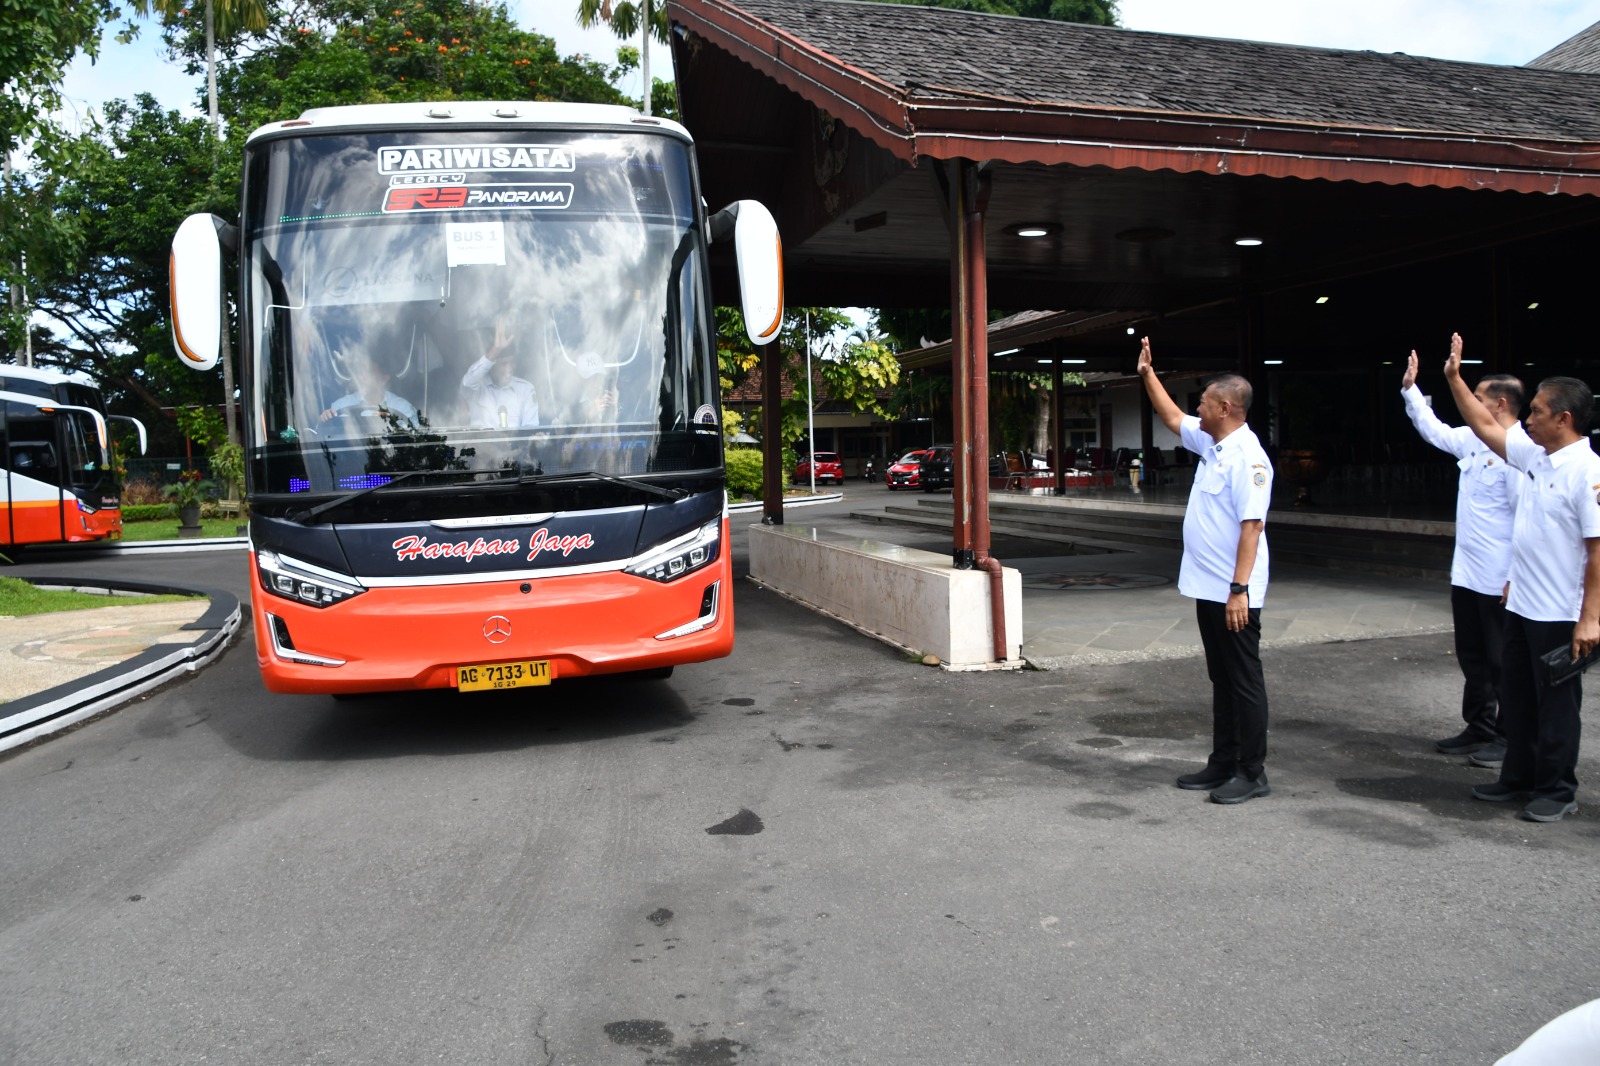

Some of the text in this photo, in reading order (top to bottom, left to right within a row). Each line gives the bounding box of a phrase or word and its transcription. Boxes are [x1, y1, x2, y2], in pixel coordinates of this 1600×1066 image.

[383, 148, 570, 171] PARIWISATA
[393, 174, 462, 185] LEGACY
[468, 190, 565, 203] PANORAMA
[453, 230, 499, 243] BUS 1
[392, 527, 595, 563] Harapan Jaya
[461, 662, 547, 684] AG 7133 UT
